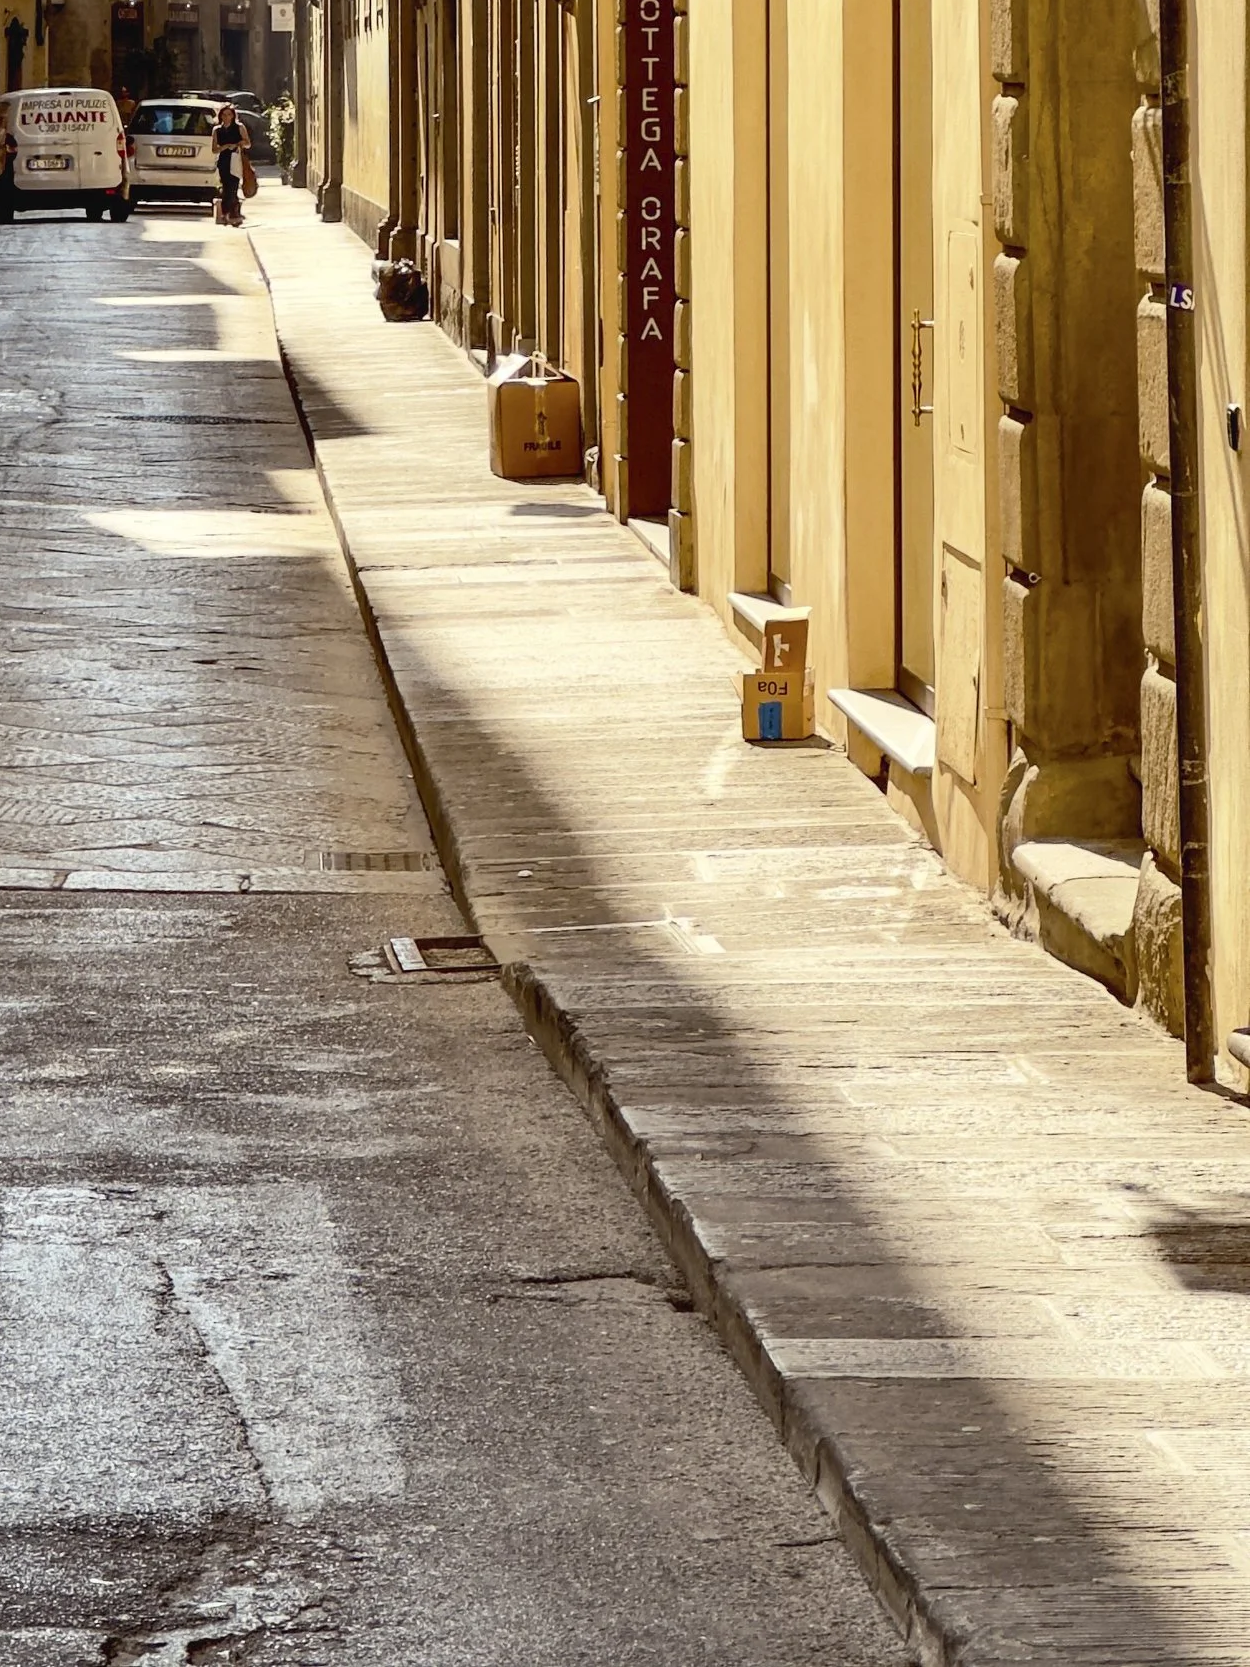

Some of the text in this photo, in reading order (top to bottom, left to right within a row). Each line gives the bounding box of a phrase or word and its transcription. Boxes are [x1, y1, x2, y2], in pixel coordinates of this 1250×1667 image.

[22, 99, 107, 110] IMPRESA DI PULIZIE
[21, 111, 108, 125] L'ALIANTE
[640, 196, 663, 341] ORAFA
